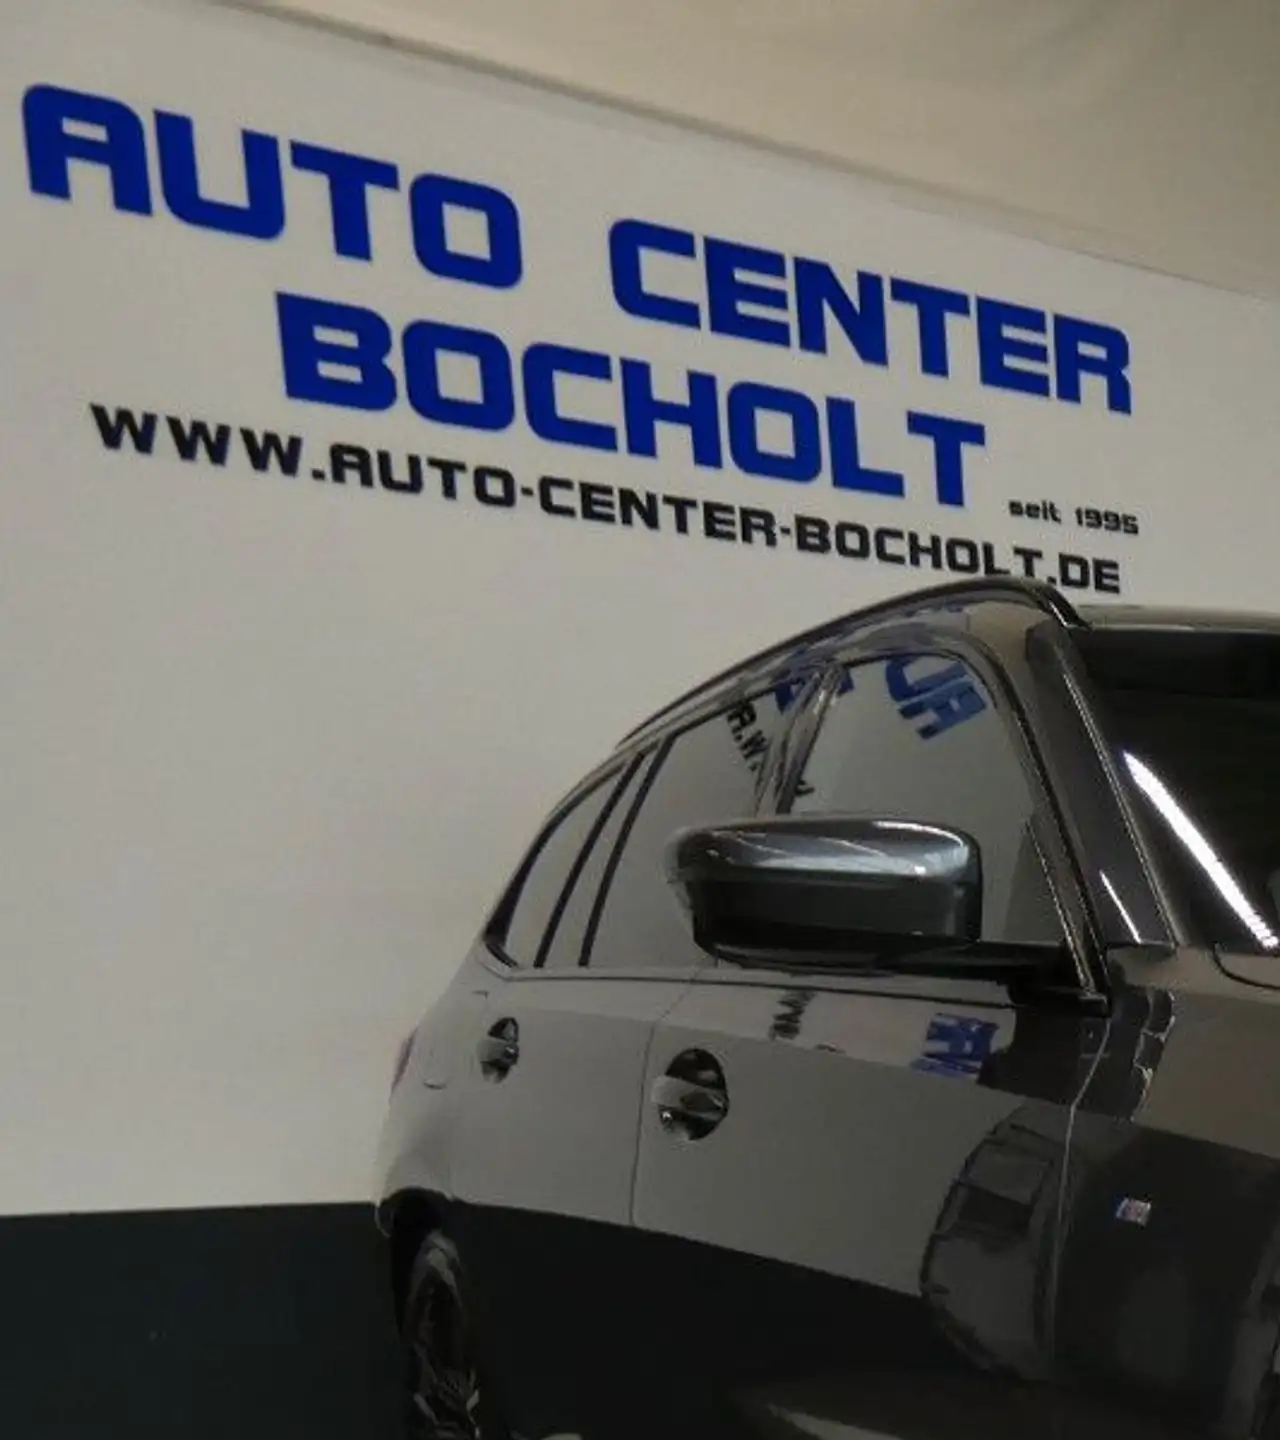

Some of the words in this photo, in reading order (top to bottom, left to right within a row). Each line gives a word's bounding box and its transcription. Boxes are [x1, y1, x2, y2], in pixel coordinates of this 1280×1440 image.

[23, 85, 523, 290] AUTO
[608, 219, 1132, 415] CENTER
[89, 403, 1121, 595] WWW.AUTO-CENTER-BOCHOLT.DE
[276, 293, 985, 507] BOCHOLT
[1008, 500, 1062, 524] seit
[1075, 507, 1139, 536] 1995
